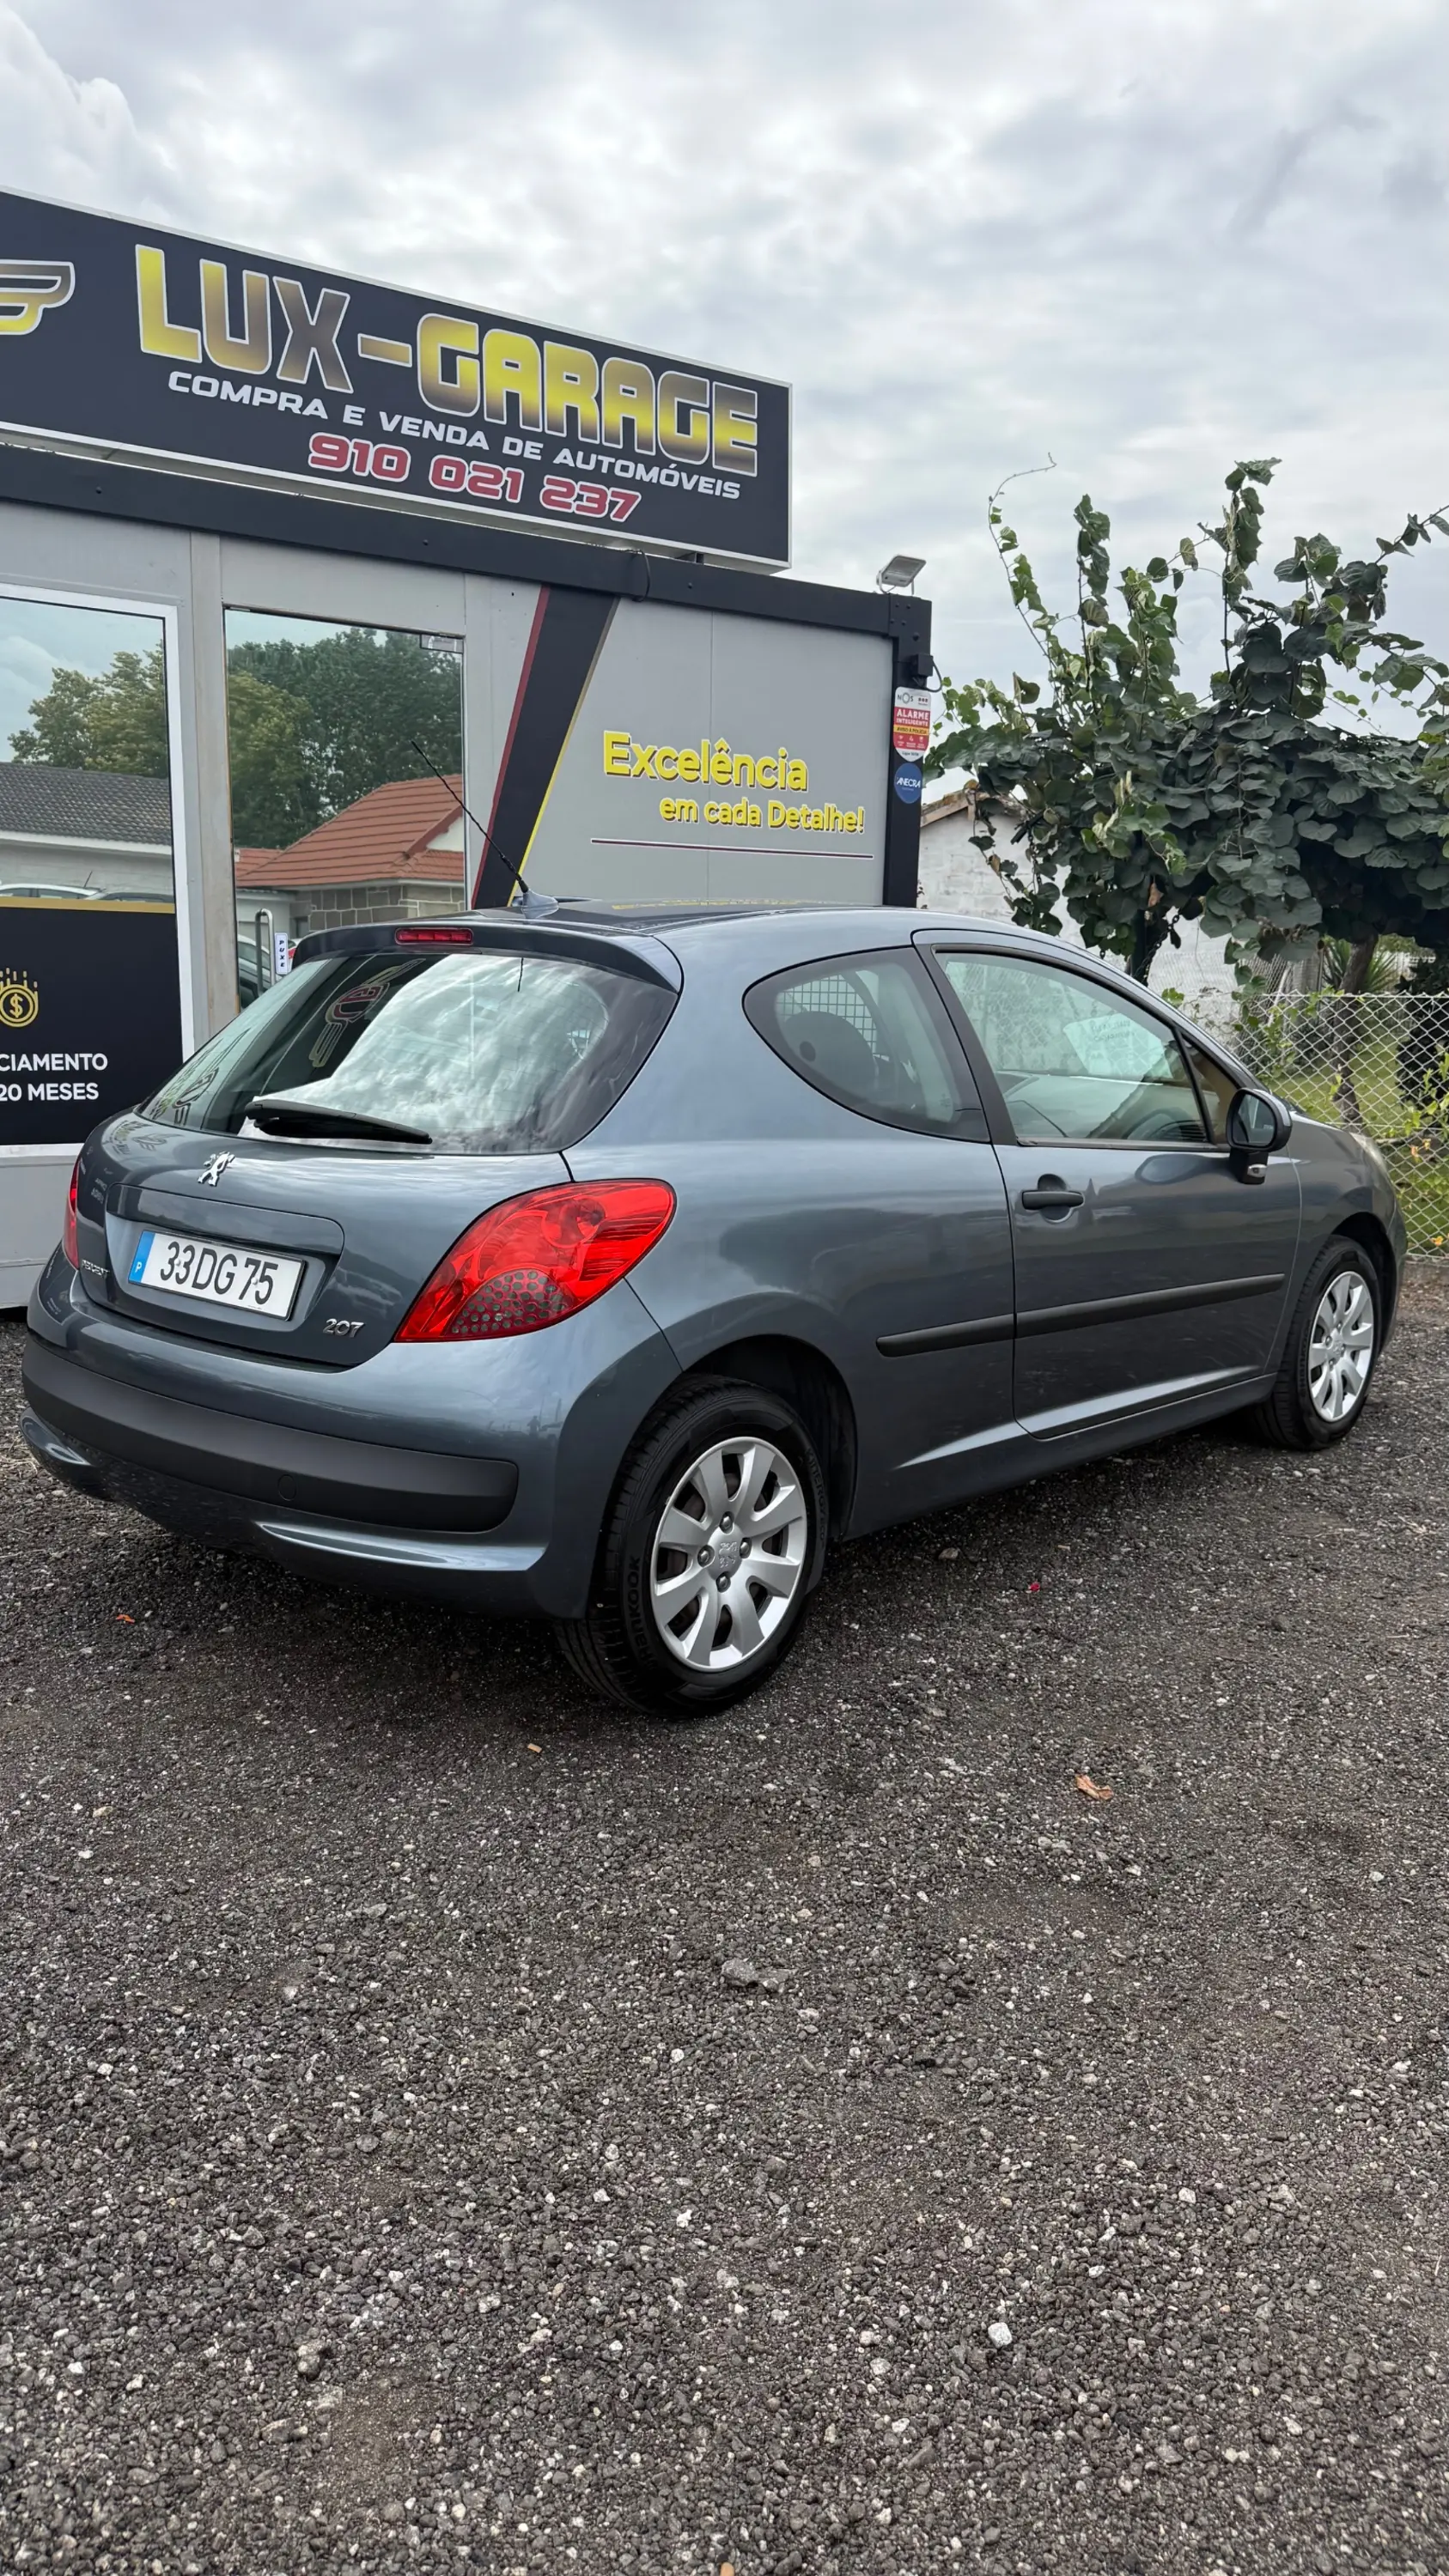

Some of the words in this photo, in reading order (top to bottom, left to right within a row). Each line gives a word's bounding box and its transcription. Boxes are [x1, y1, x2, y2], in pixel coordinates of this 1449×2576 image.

[135, 244, 758, 477] LUX-GARAGE
[168, 371, 328, 420] COMPRA
[343, 404, 366, 426] E
[379, 411, 490, 450] VENDA
[502, 436, 544, 460] DE
[552, 448, 740, 500] AUTOMÓVEIS
[307, 431, 411, 482] 910
[429, 454, 525, 503] 021
[540, 475, 642, 523] 237
[896, 718, 928, 727] INTELIGENTE
[897, 708, 929, 720] ALARME
[604, 730, 808, 793] Excelência
[896, 777, 921, 788] ANECRA
[659, 797, 698, 823] em
[703, 798, 763, 829] cada
[768, 800, 865, 834] Detalhe!
[0, 1053, 108, 1072] CIAMENTO
[27, 1082, 100, 1102] MESES
[134, 1261, 143, 1273] P
[322, 1318, 364, 1338] 207
